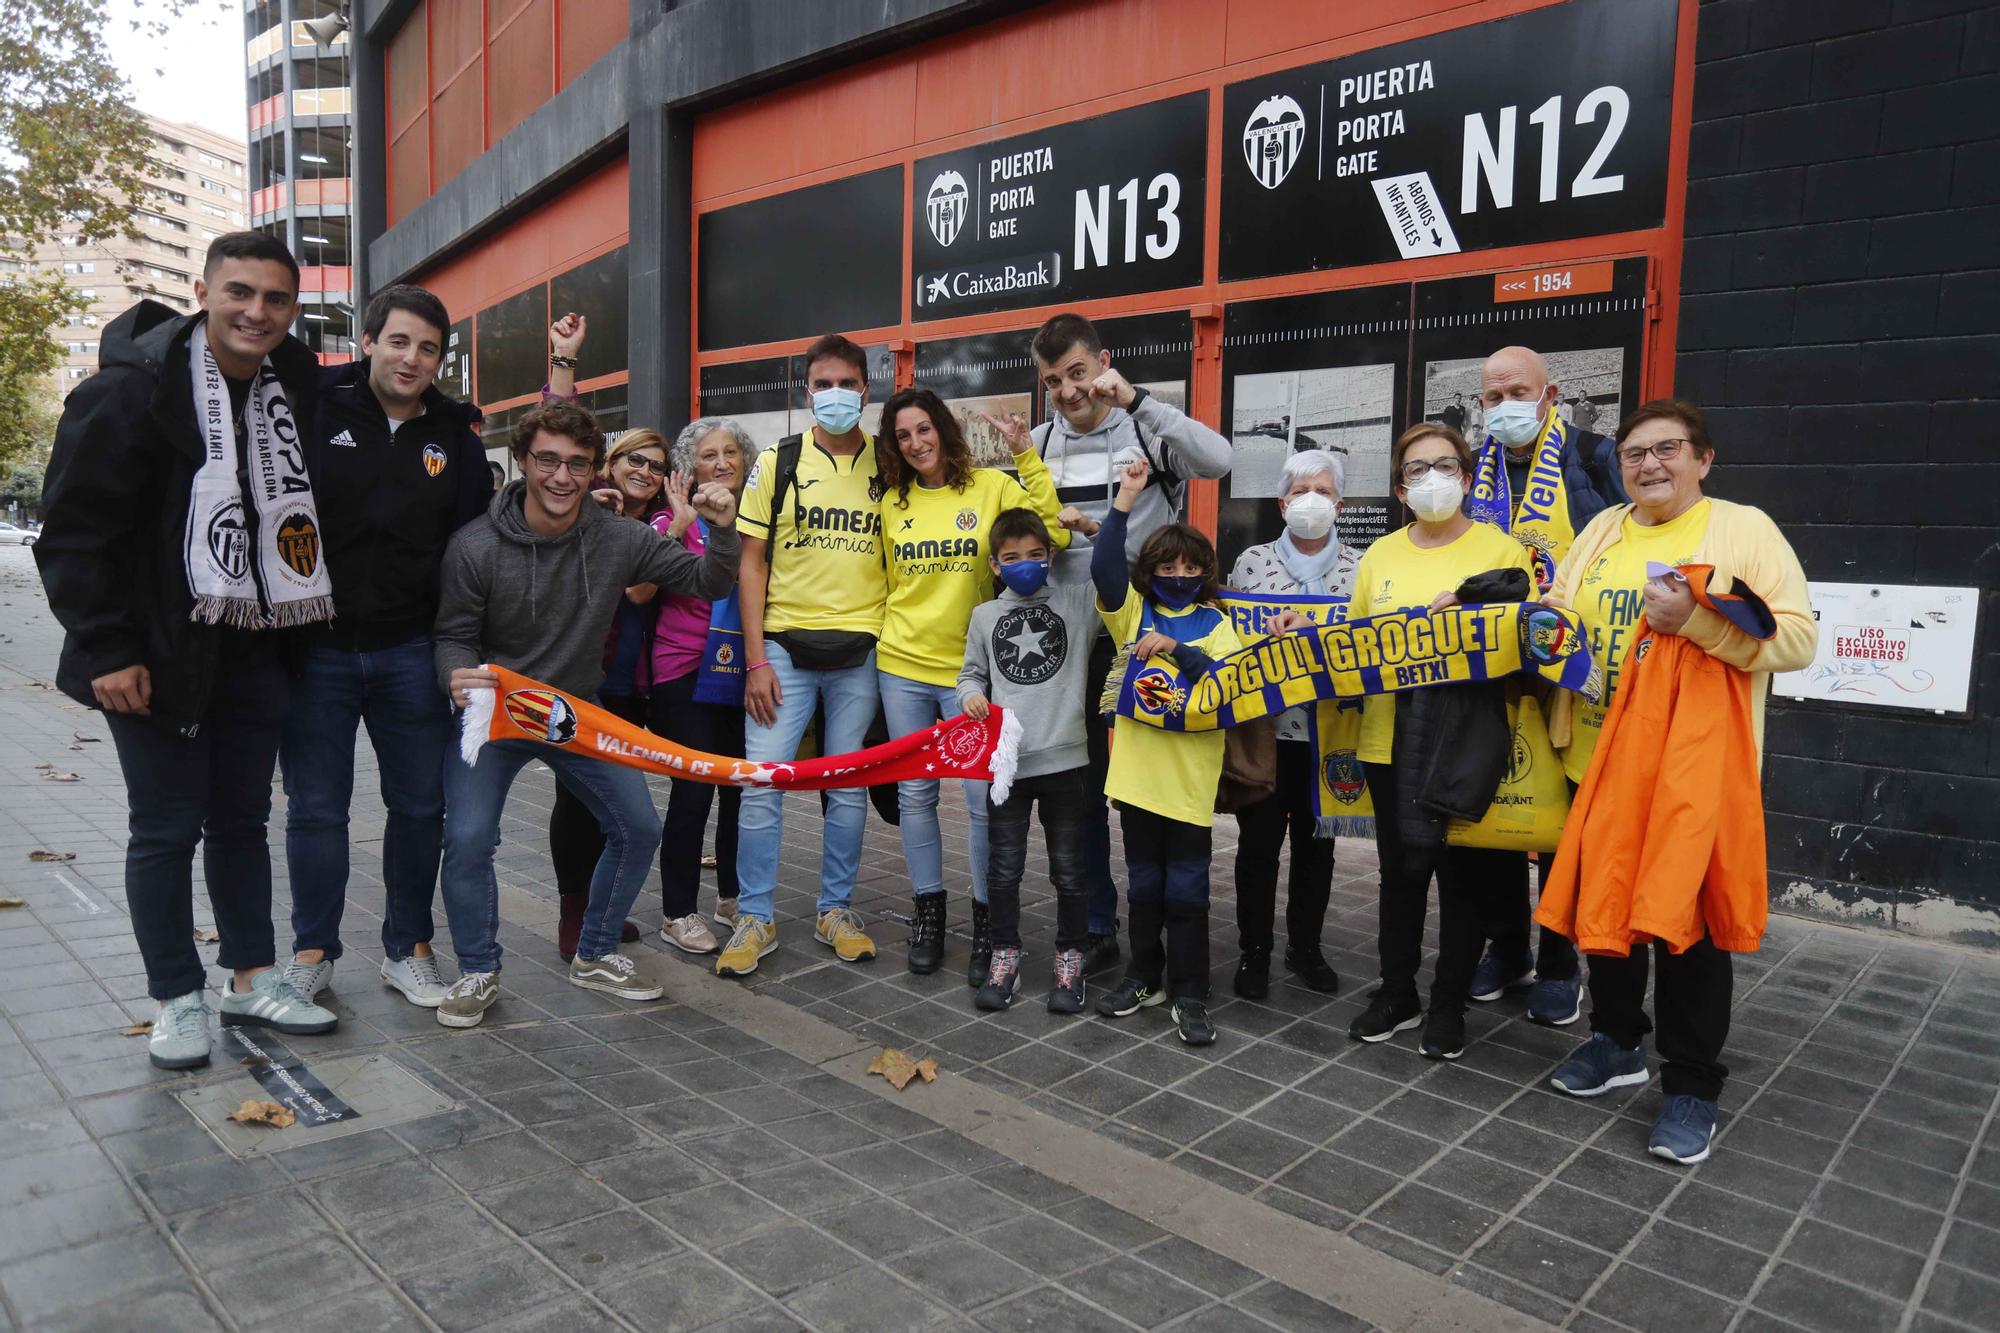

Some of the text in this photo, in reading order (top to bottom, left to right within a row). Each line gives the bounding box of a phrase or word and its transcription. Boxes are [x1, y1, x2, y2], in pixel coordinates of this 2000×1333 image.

[1339, 60, 1434, 108] PUERTA
[1249, 125, 1284, 137] VALENCIA
[1337, 109, 1405, 146] PORTA
[990, 146, 1054, 183] PUERTA
[1336, 150, 1378, 178] GATE
[1461, 85, 1630, 214] N12
[989, 185, 1035, 214] PORTA
[1386, 183, 1421, 247] INFANTILES
[1406, 180, 1436, 227] ABONOS
[989, 218, 1018, 239] GATE
[1074, 172, 1181, 271] N13
[952, 260, 1049, 297] CaixaBank
[1532, 271, 1572, 293] 1954
[256, 422, 267, 436] FC
[266, 395, 310, 495] COPA
[329, 438, 357, 448] adidas
[257, 438, 278, 502] BARCELONA
[1518, 423, 1564, 524] Yellow
[798, 505, 881, 537] PAMESA
[894, 537, 979, 562] PAMESA
[997, 608, 1056, 639] CONVERSE
[1323, 606, 1506, 672] GROGUET
[1859, 628, 1885, 638] USO
[1836, 637, 1906, 650] EXCLUSIVO
[1836, 647, 1904, 661] BOMBEROS
[1006, 654, 1058, 678] ALL STAR
[1199, 635, 1324, 714] ORGULL
[596, 732, 715, 776] VALENCIA CF
